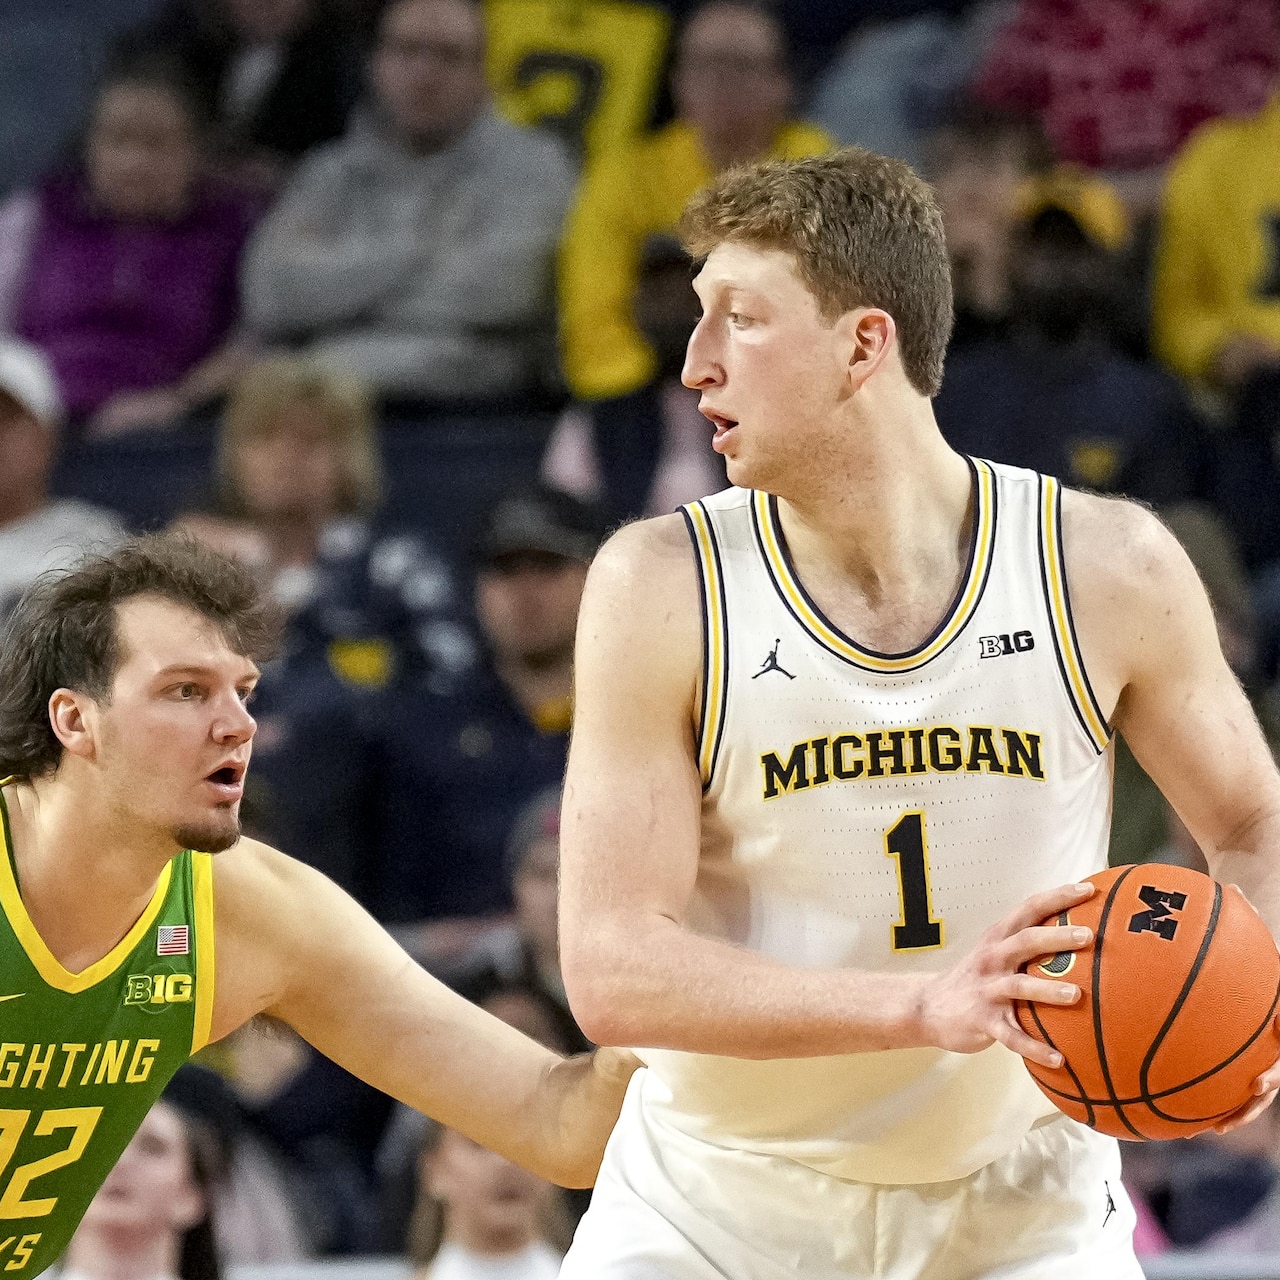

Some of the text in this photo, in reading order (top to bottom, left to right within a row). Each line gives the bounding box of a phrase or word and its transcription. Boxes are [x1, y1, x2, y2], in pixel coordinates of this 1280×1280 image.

[759, 724, 1047, 802] MICHIGAN
[883, 808, 945, 953] 1
[1128, 885, 1188, 941] M
